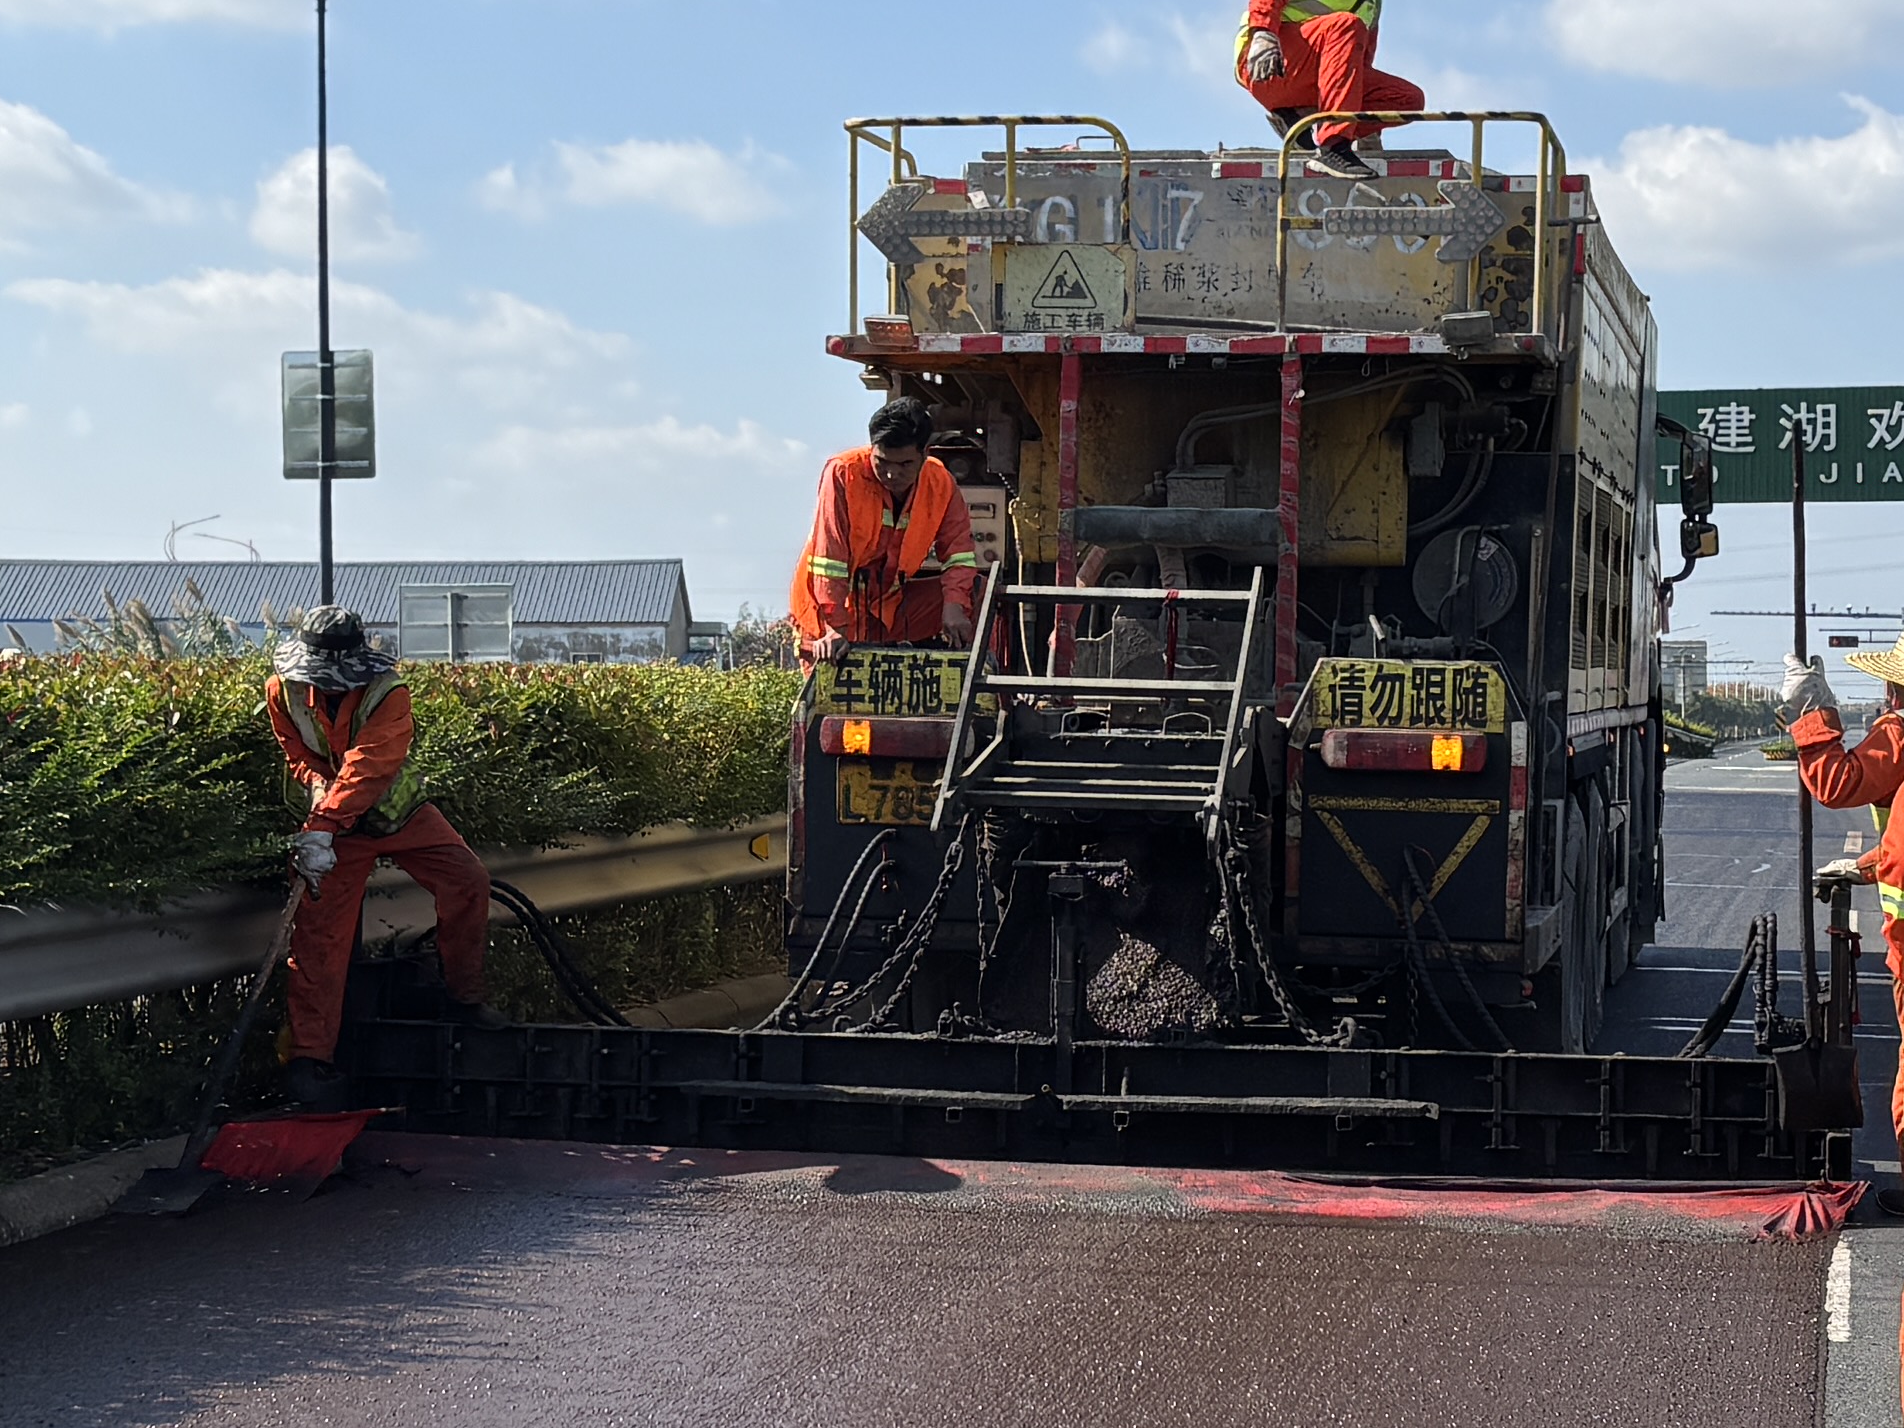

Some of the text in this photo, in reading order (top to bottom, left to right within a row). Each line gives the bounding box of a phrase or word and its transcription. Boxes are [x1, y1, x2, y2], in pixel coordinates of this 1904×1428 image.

[1022, 310, 1105, 331] 施工车辆
[1328, 663, 1489, 729] 请勿跟随
